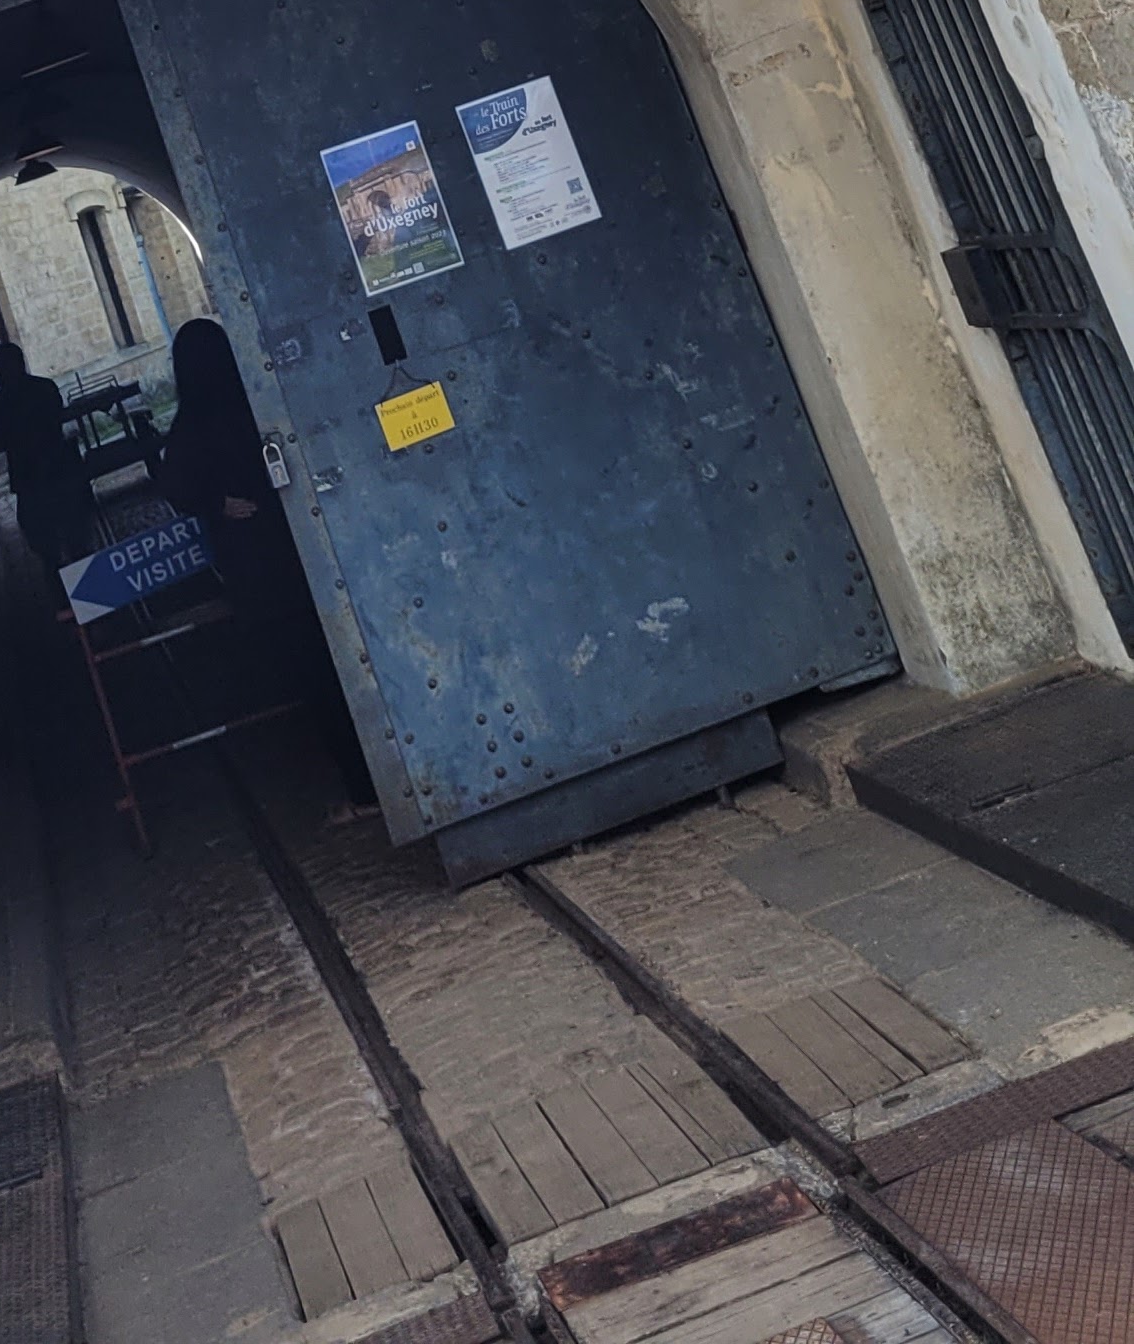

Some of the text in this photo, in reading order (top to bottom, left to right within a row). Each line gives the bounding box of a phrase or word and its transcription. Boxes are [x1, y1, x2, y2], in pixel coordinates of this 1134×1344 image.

[475, 106, 527, 136] des Forts
[489, 96, 519, 115] Train
[390, 192, 427, 214] le fort
[363, 202, 438, 237] d'Uxegney
[109, 517, 202, 572] DEPART
[126, 545, 206, 592] VISITE
